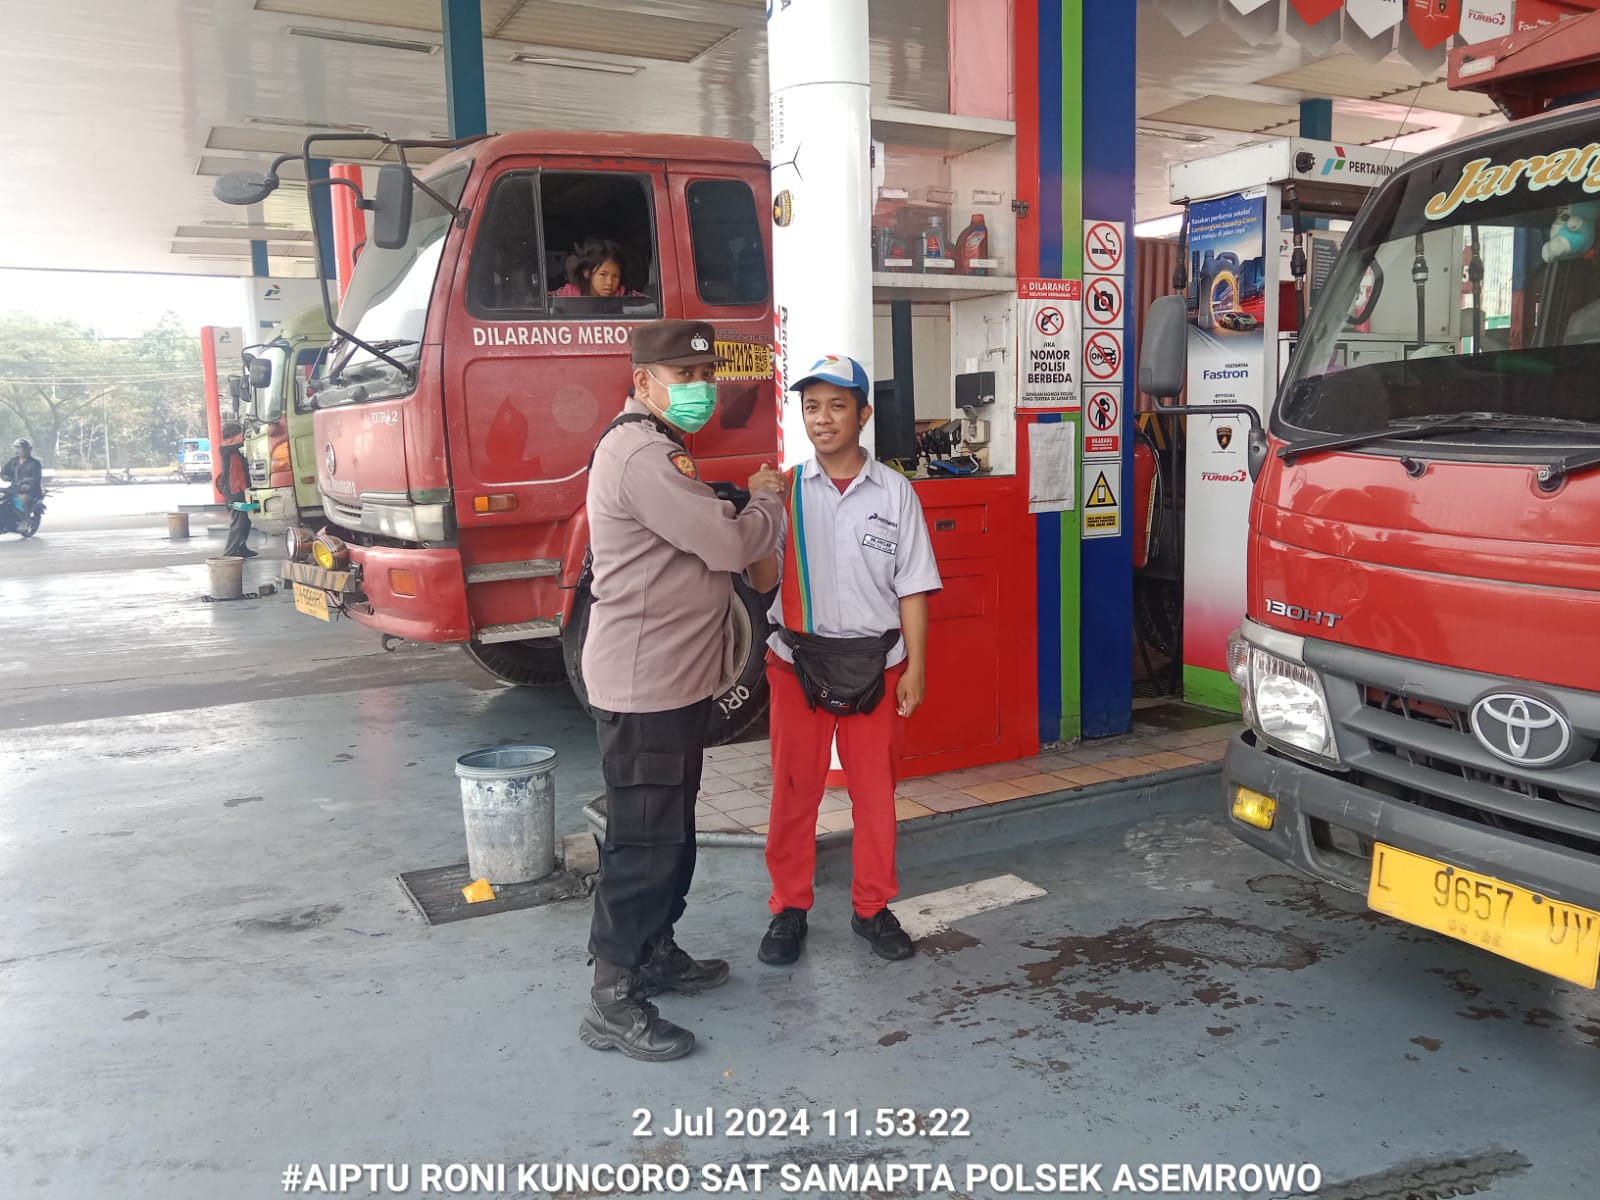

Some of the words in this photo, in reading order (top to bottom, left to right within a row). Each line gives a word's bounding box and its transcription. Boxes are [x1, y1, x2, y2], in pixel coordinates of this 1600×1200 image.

[1467, 13, 1500, 26] TURBO
[1425, 143, 1600, 220] Jaran
[1029, 282, 1070, 292] DILARANG
[472, 326, 572, 346] DILARANG
[578, 326, 633, 344] MERO
[781, 306, 789, 406] PERTAMAX
[1030, 350, 1070, 360] NOMOR
[1033, 361, 1065, 372] POLISI
[1027, 373, 1072, 384] BERBEDA
[1203, 370, 1249, 380] Fastron
[1201, 474, 1239, 482] TURBO
[1265, 598, 1343, 628] 130HT
[1377, 852, 1391, 892] L
[1433, 869, 1514, 928] 9657
